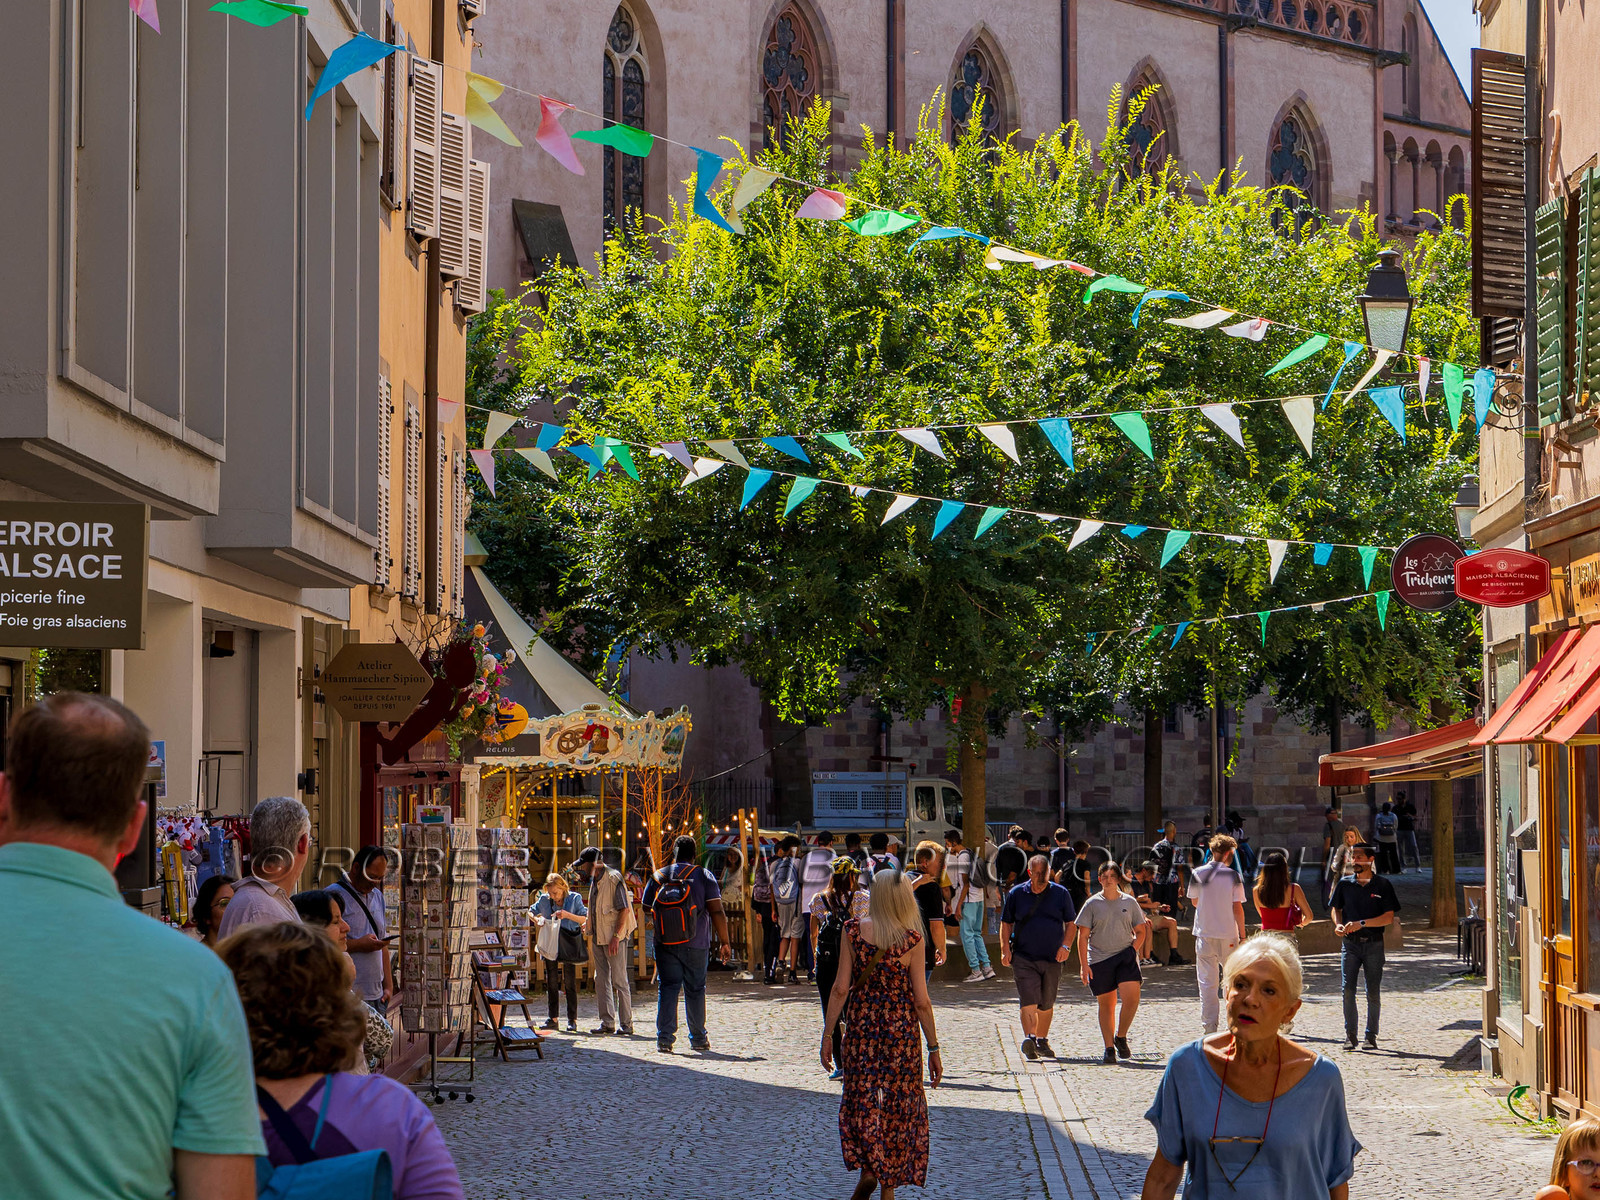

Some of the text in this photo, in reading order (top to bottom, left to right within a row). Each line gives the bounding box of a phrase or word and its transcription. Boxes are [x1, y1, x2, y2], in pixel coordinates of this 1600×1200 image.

[1404, 556, 1418, 570] Les
[1400, 570, 1455, 589] Tricheurs
[1465, 572, 1540, 581] MAISON ALSACIENNE
[56, 589, 85, 604] fine
[0, 612, 127, 631] Foie gras alsaciens
[357, 660, 393, 670] Atelier
[324, 673, 426, 686] Hammaecher Sipion
[376, 693, 411, 702] CRÉATEUR
